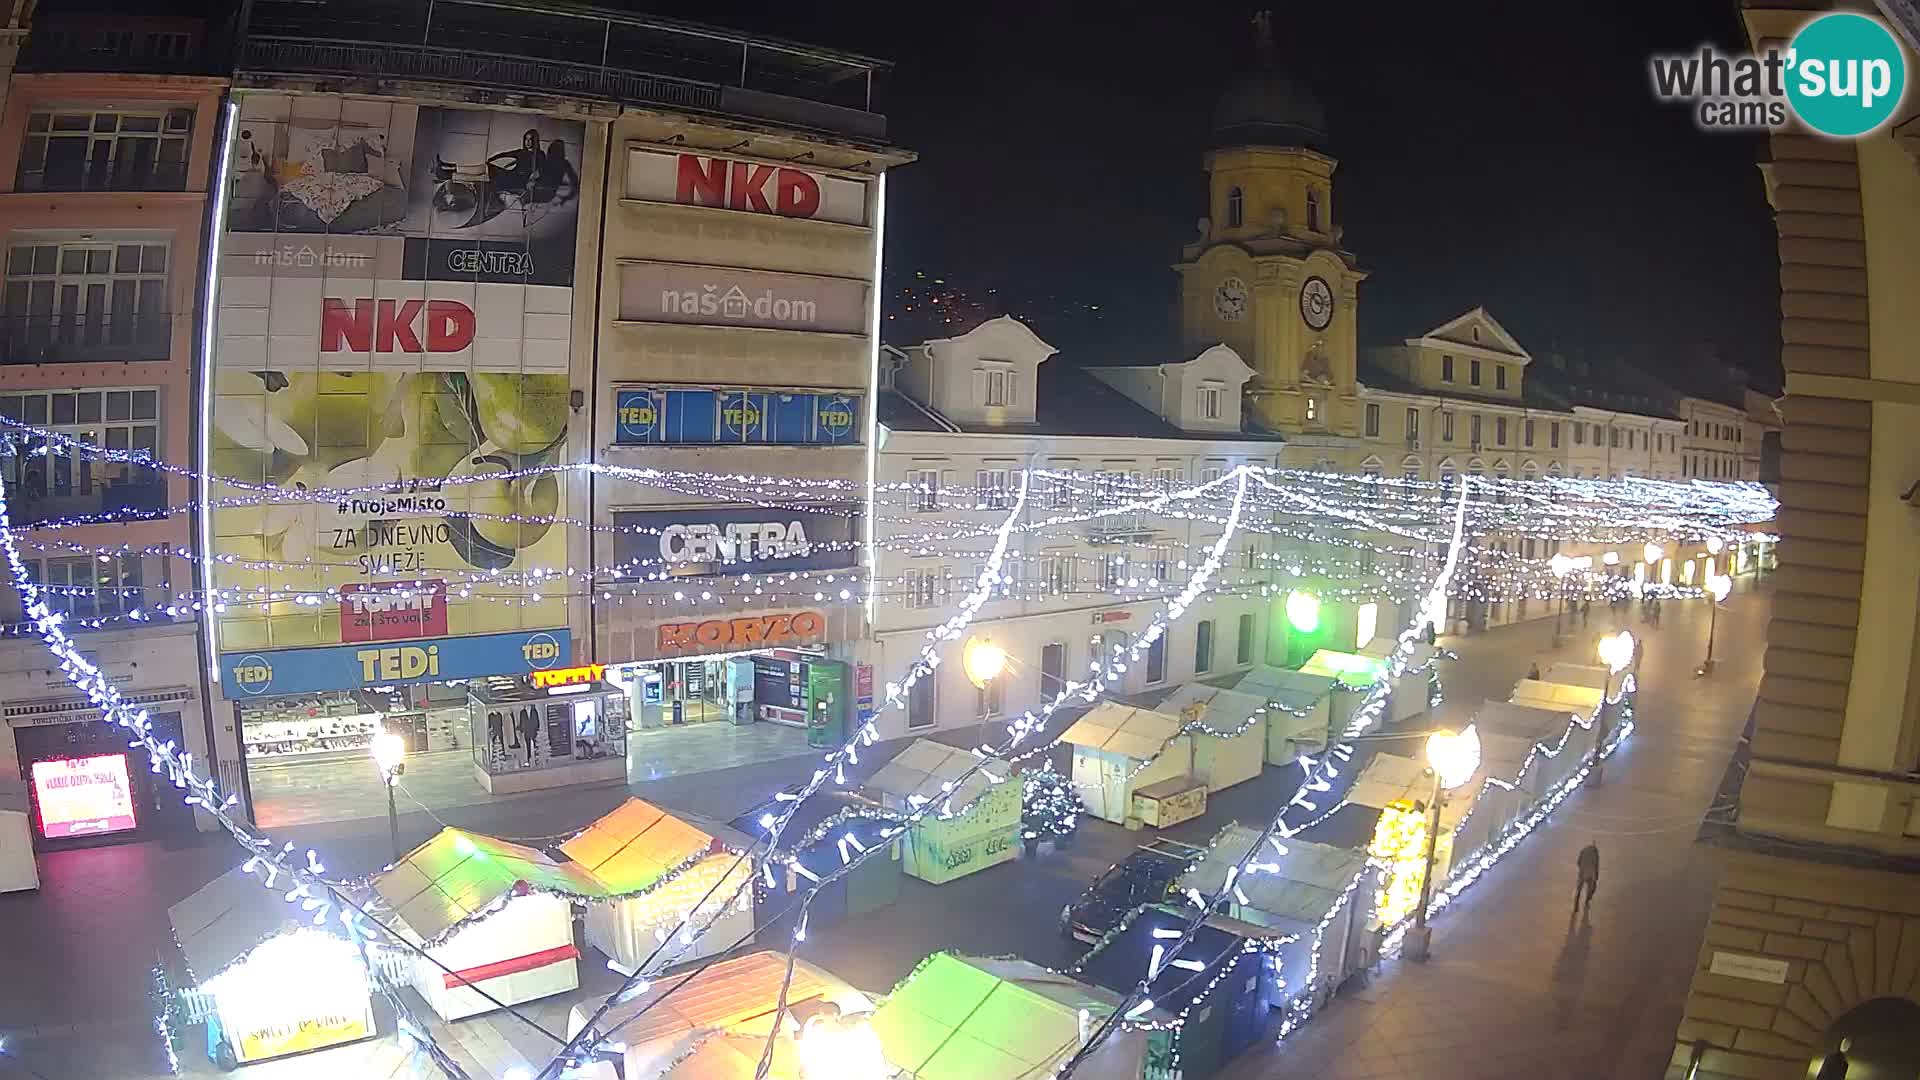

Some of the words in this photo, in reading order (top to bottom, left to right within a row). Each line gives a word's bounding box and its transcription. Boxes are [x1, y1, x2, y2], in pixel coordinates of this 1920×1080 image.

[675, 153, 821, 219] NKD
[255, 245, 291, 267] naš
[320, 245, 365, 268] dom
[447, 249, 534, 275] CENTRA
[661, 283, 719, 316] naš
[754, 288, 817, 321] dom
[320, 297, 477, 353] NKD
[338, 496, 446, 517] #TvojeMisto
[333, 528, 357, 549] ZA
[366, 523, 450, 548] DNEVNO
[659, 520, 811, 563] CENTRA
[659, 611, 826, 652] KORZO
[357, 645, 440, 682] TEDi
